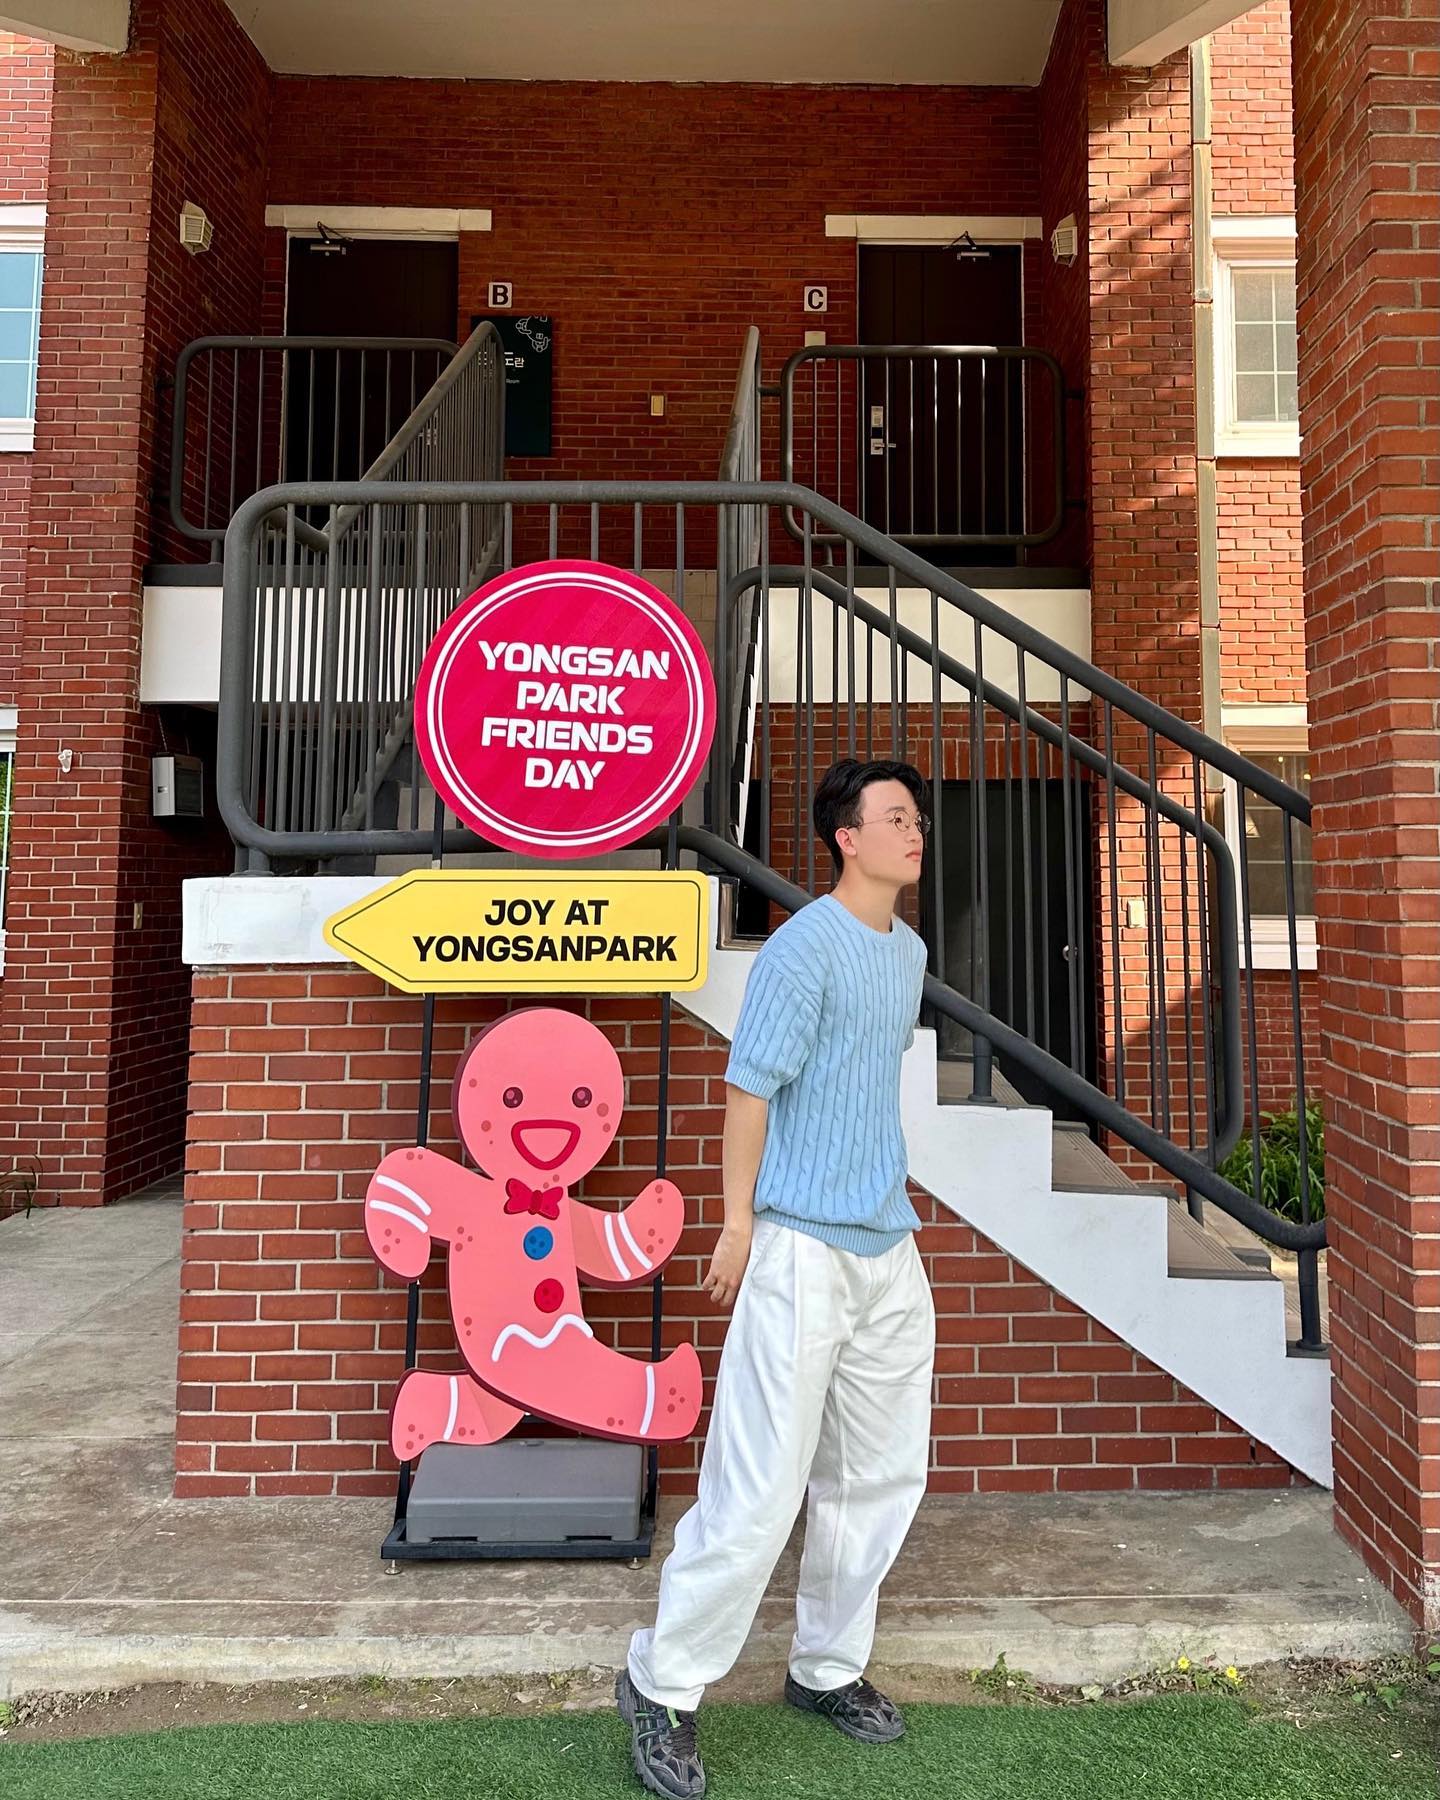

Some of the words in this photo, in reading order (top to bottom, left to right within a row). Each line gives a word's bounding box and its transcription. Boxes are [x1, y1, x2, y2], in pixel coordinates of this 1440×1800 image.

[492, 284, 509, 306] B
[808, 289, 824, 310] C
[478, 640, 670, 680] YONGSAN
[516, 681, 626, 715] PARK
[481, 717, 653, 754] FRIENDS
[524, 758, 605, 790] DAY
[484, 900, 556, 926] JOY
[565, 900, 609, 926] AT
[412, 936, 677, 962] YONGSANPARK
